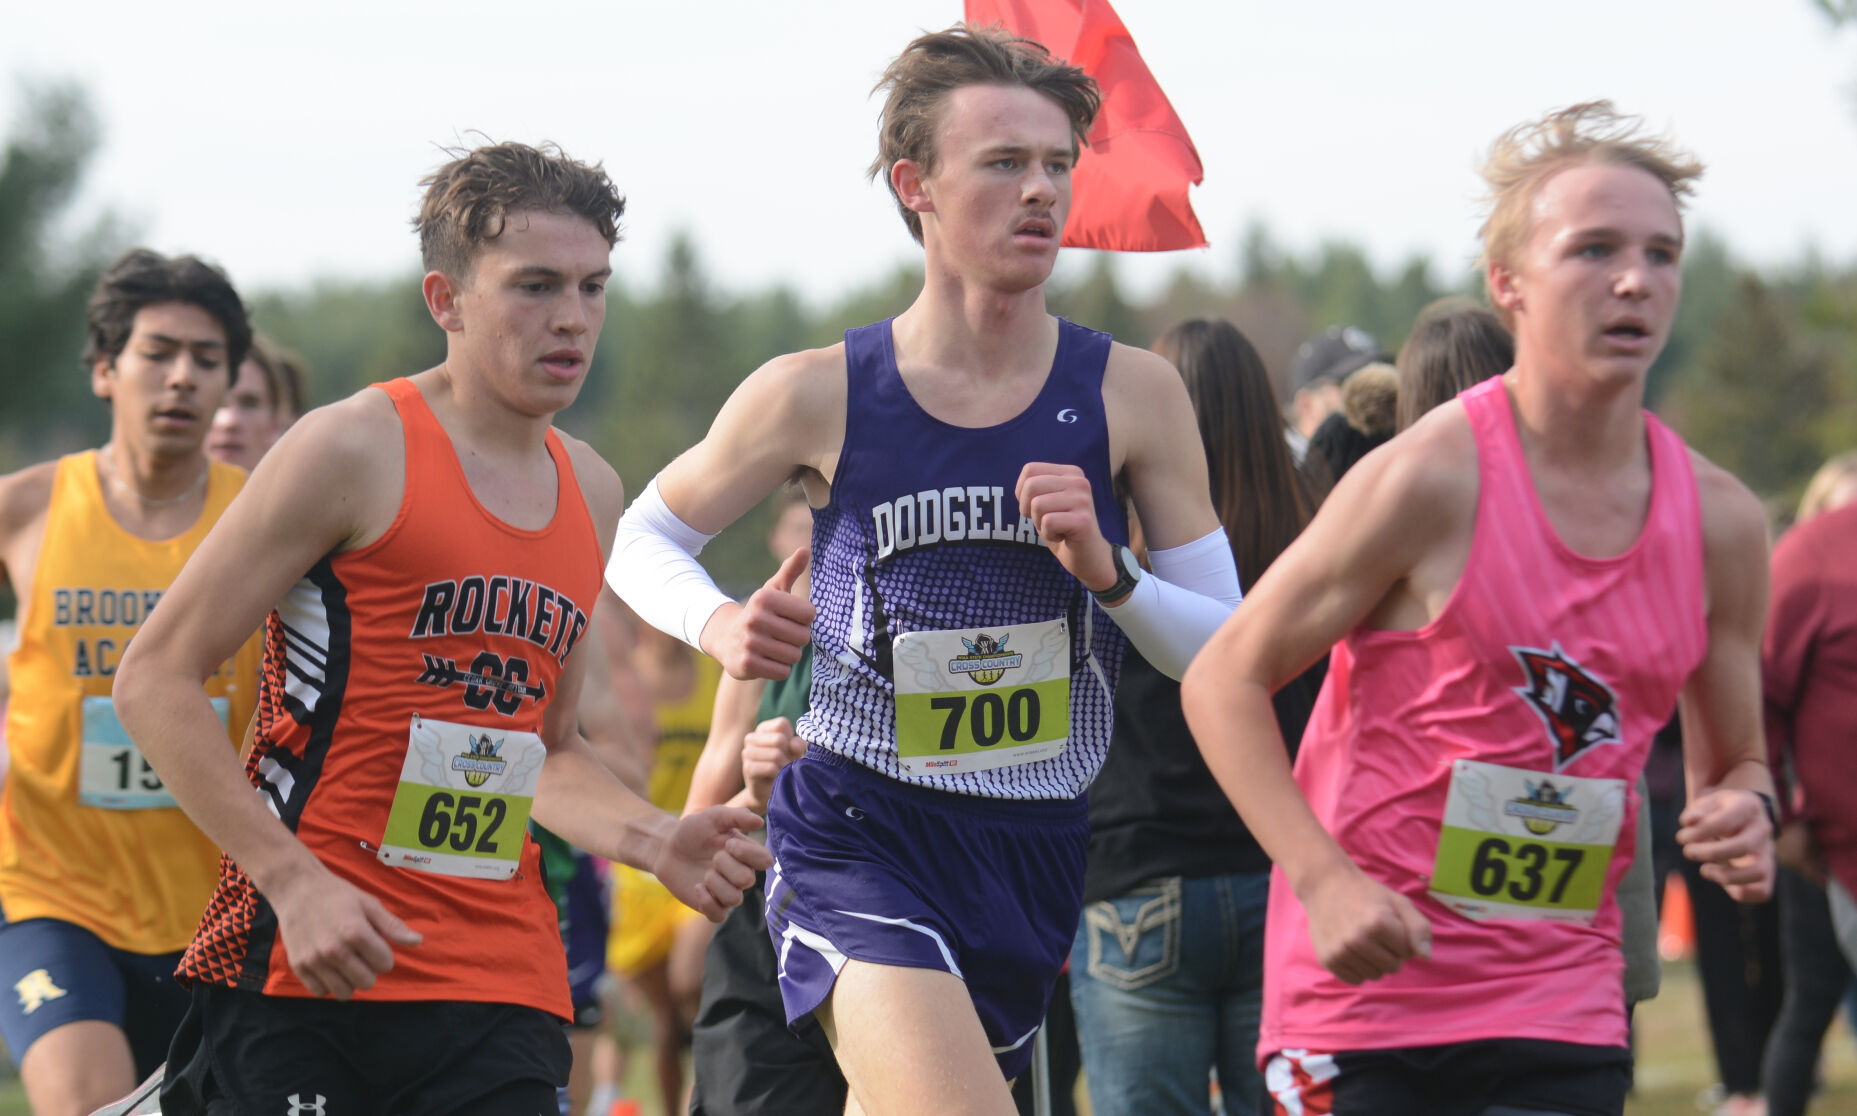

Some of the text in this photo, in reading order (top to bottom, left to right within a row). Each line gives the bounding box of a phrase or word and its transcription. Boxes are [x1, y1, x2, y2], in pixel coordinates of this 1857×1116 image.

[872, 486, 1048, 559] DODGELA
[408, 574, 588, 669] ROCKETS
[951, 660, 980, 672] CROSS
[982, 655, 1021, 669] COUNTRY
[931, 688, 1041, 750] 700
[453, 757, 505, 773] CROSS COUNTRY
[418, 792, 507, 854] 652
[1470, 837, 1587, 903] 637
